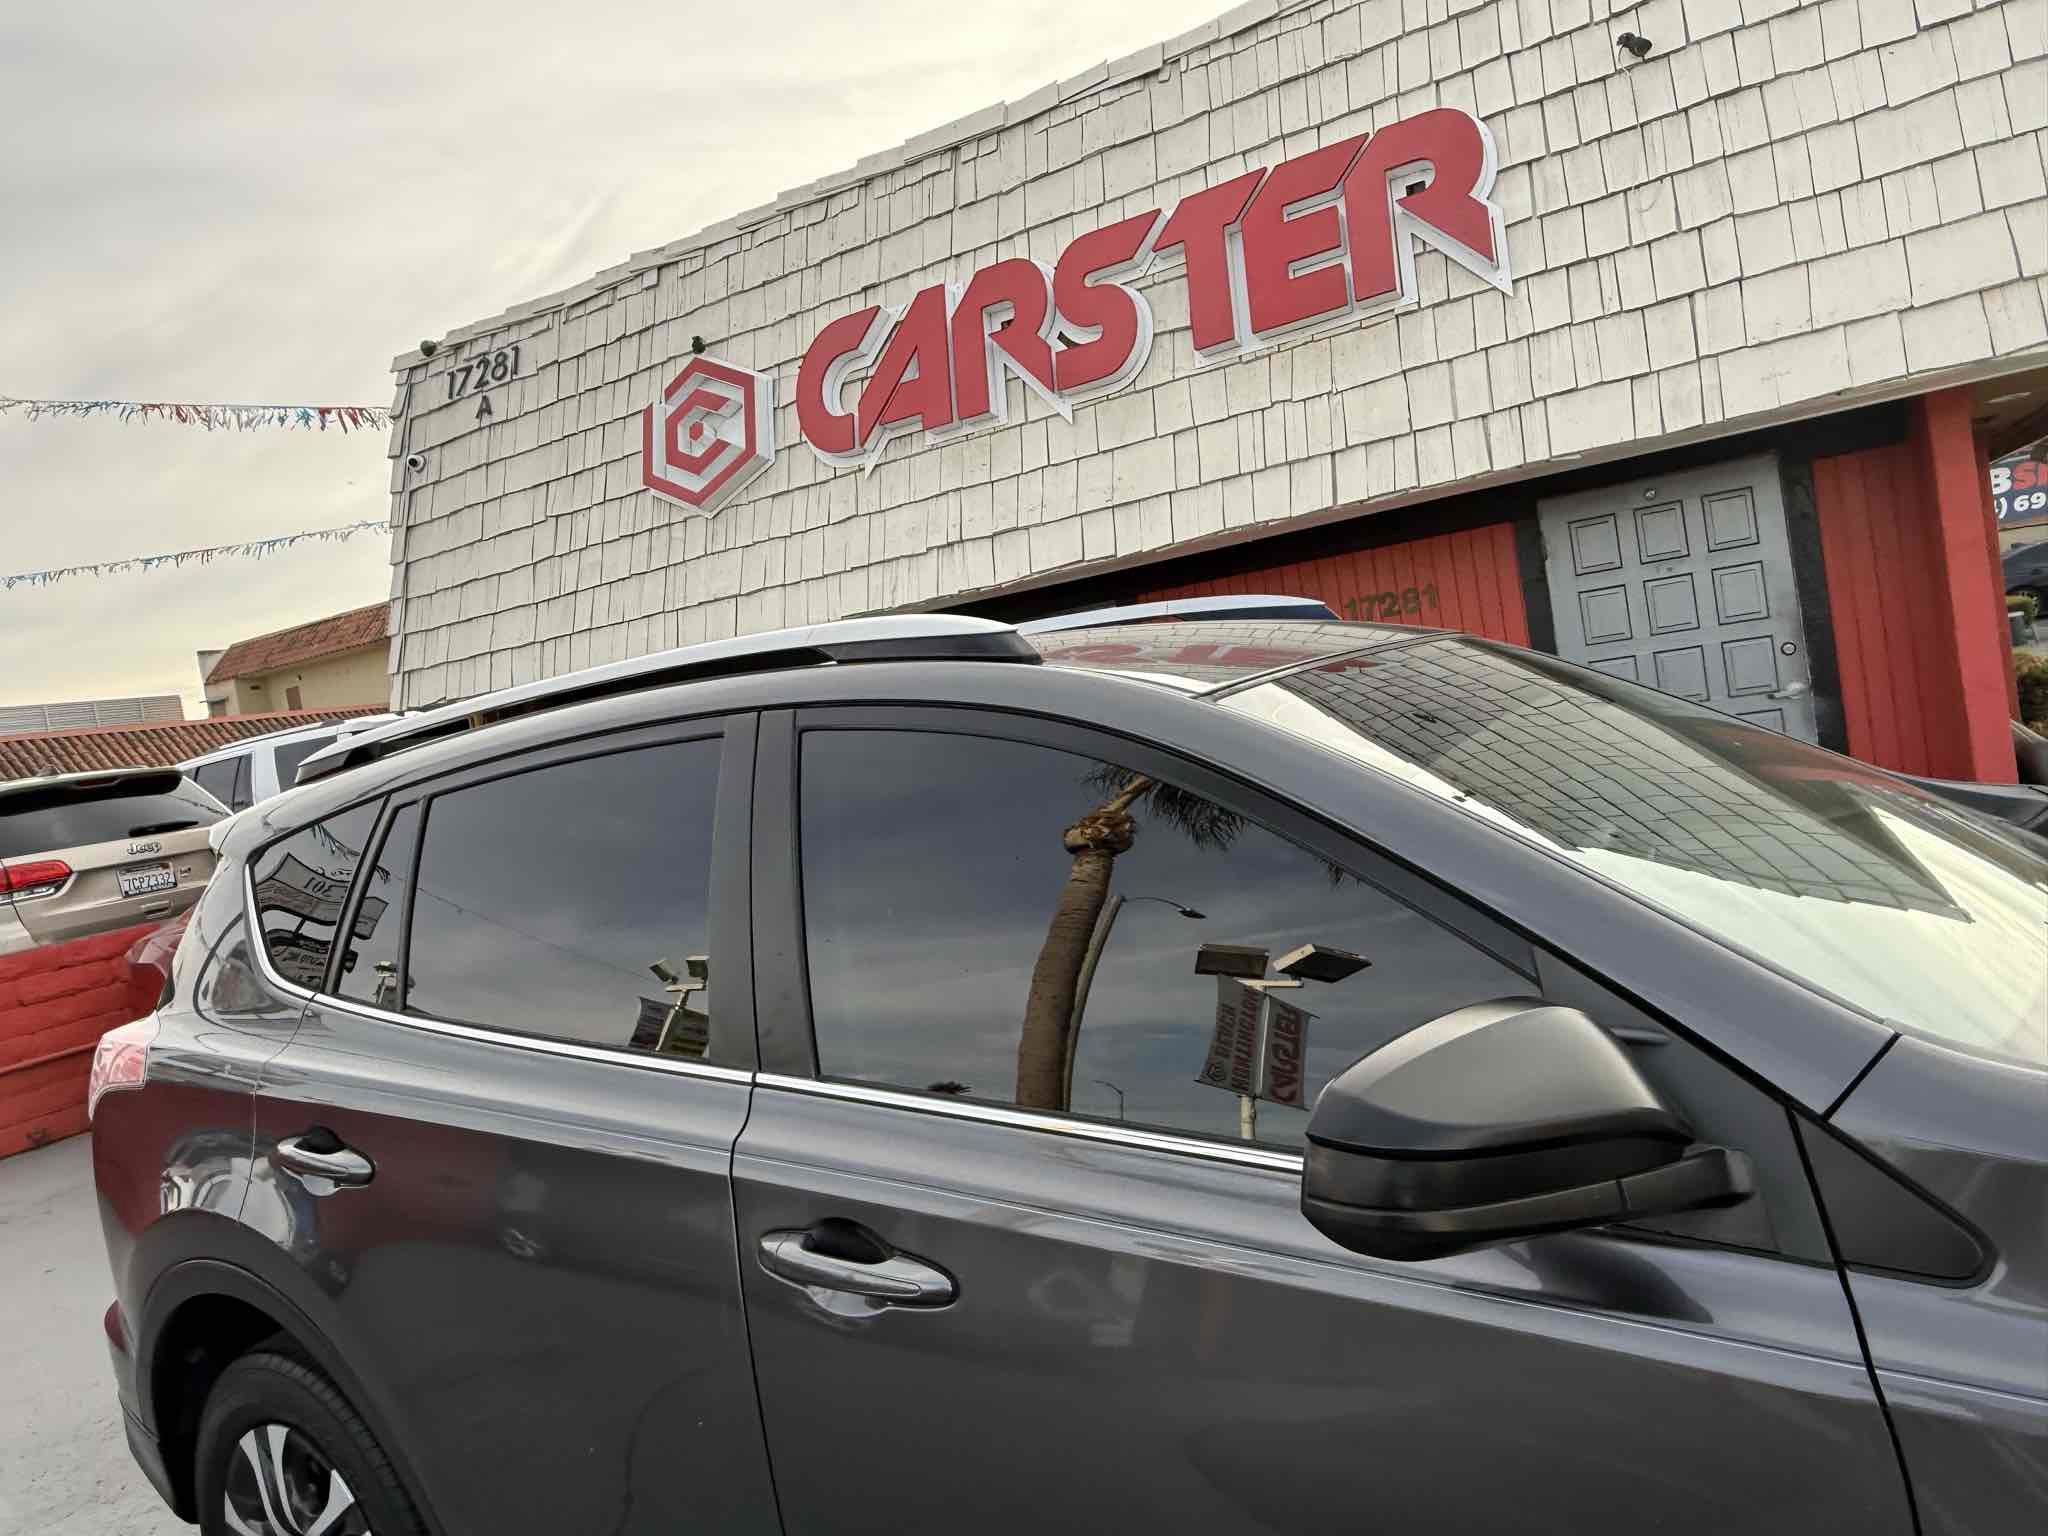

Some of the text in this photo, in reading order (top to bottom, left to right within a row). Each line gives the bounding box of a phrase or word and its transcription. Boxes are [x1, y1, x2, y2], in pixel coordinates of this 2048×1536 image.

[796, 107, 1506, 464] CARSTER
[447, 345, 519, 400] 17281
[475, 395, 492, 419] A
[1346, 580, 1436, 620] 17281
[127, 841, 161, 855] Jeep
